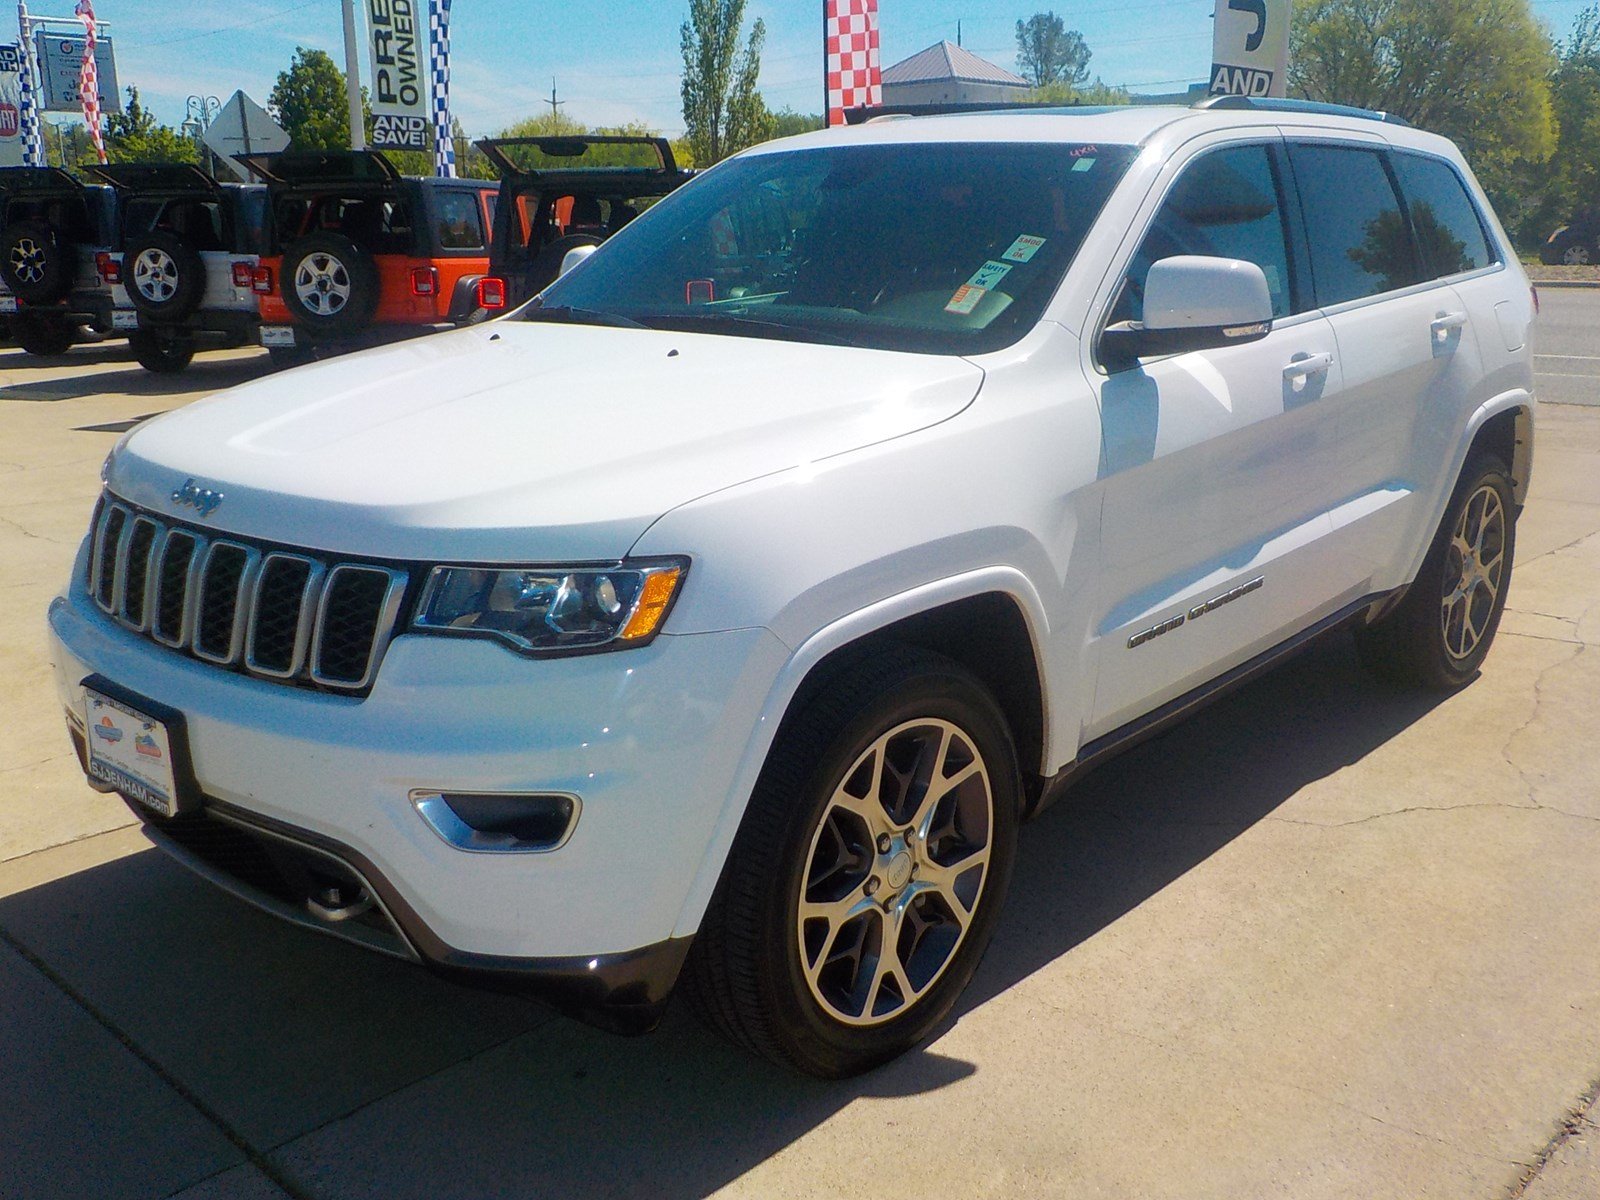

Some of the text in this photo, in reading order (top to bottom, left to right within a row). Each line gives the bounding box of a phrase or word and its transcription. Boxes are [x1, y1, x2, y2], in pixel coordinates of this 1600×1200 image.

[371, 0, 397, 103] PRE
[392, 0, 419, 106] OWNED
[1210, 67, 1270, 97] AND
[373, 116, 425, 131] AND
[372, 130, 426, 146] SAVE!
[974, 278, 988, 287] OK
